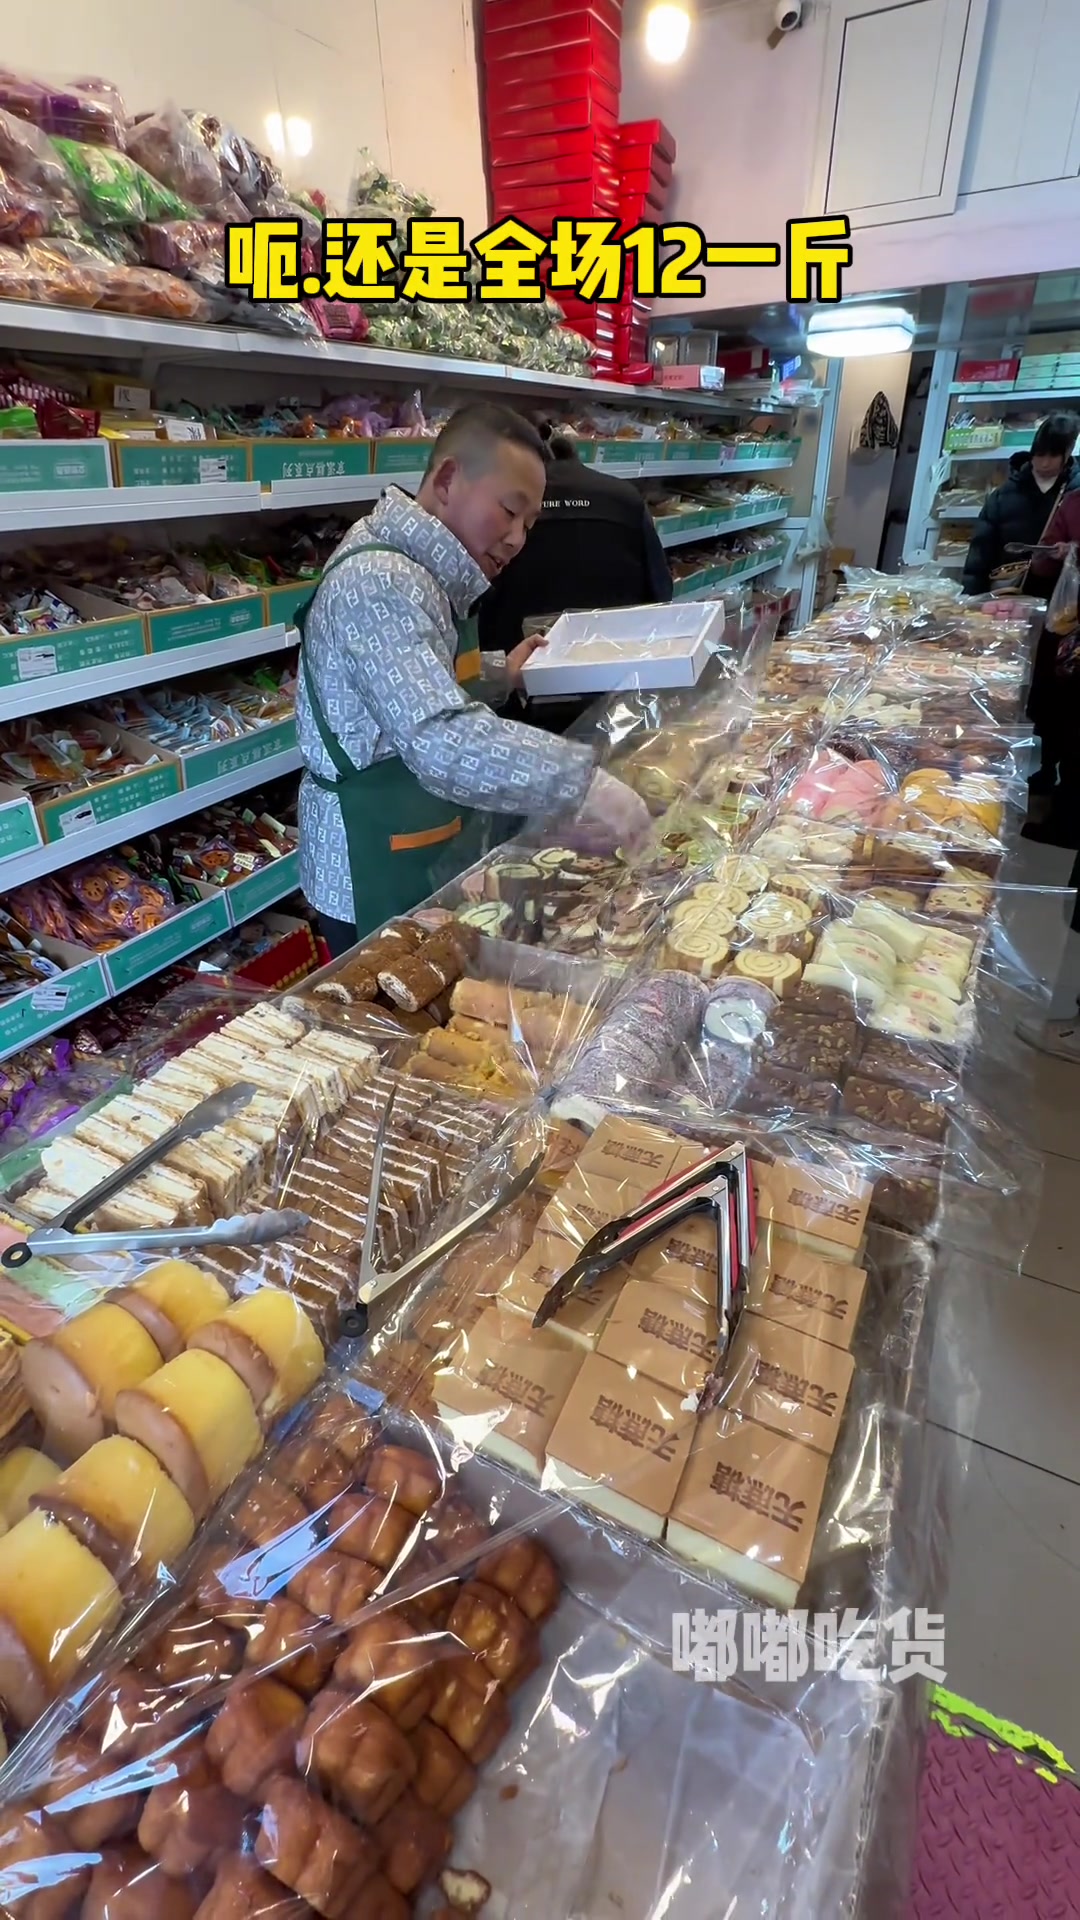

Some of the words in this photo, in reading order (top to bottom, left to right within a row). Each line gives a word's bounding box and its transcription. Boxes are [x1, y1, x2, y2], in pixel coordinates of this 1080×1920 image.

[666, 1236, 719, 1275] 蔗糖
[768, 1273, 849, 1320] 无蔗糖
[755, 1358, 839, 1417] 无蔗糖
[589, 1393, 680, 1463] 无蔗糖
[709, 1460, 807, 1533] 无蔗糖
